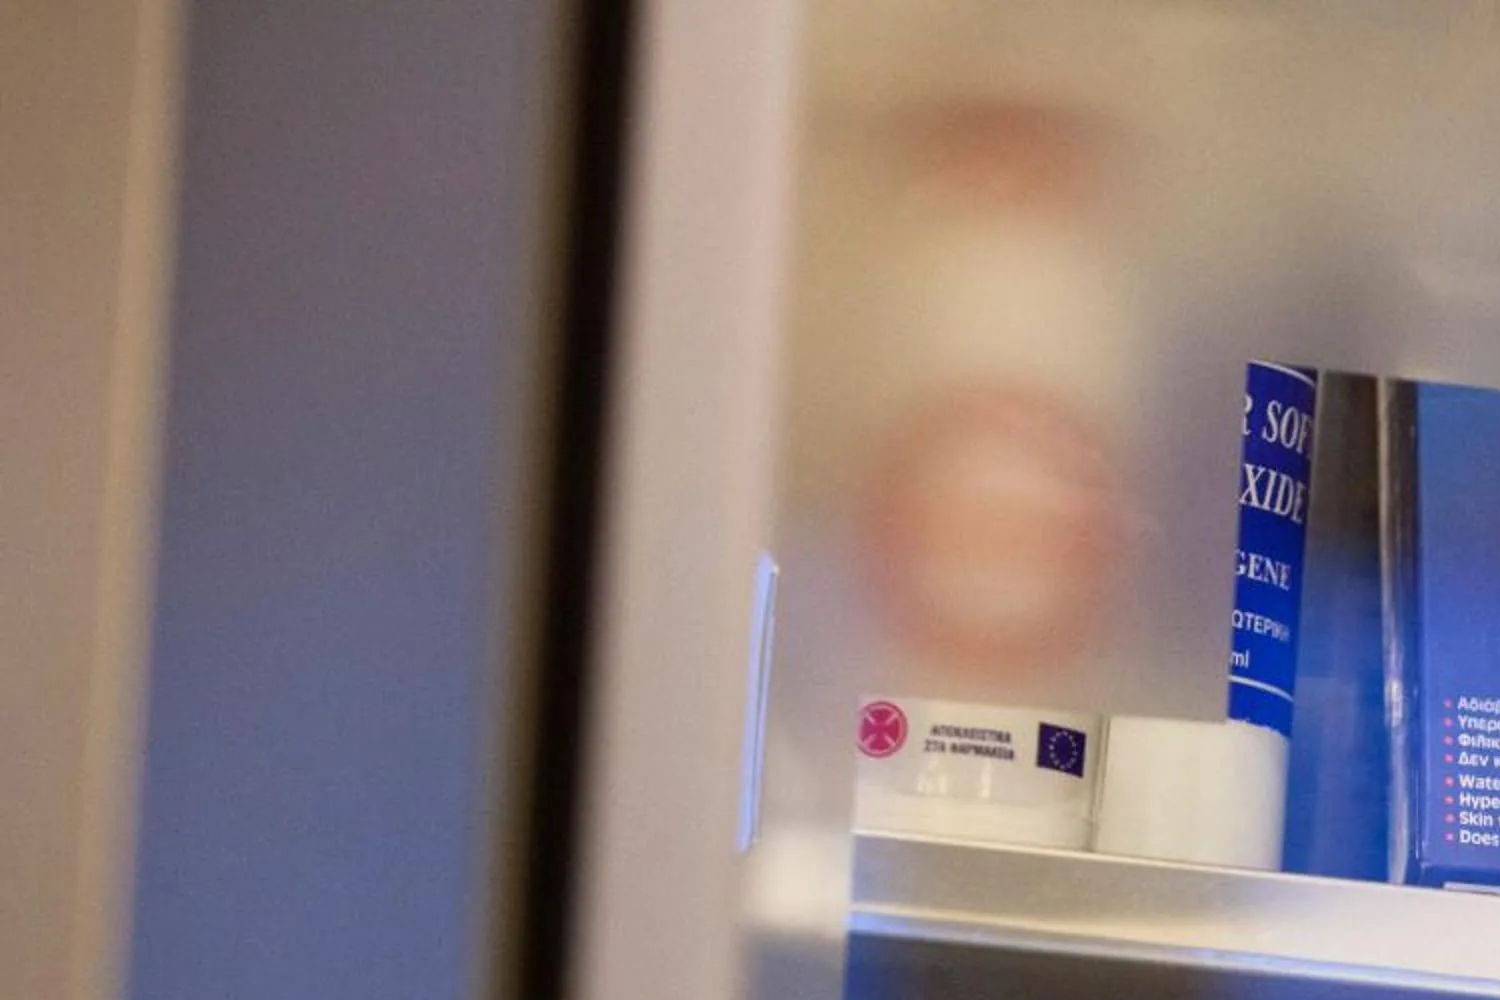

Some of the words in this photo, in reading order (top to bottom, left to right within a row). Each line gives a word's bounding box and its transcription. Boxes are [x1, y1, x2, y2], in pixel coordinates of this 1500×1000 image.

[1457, 752, 1488, 766] Δεν
[1459, 813, 1494, 828] Skin
[1460, 830, 1499, 846] Does
